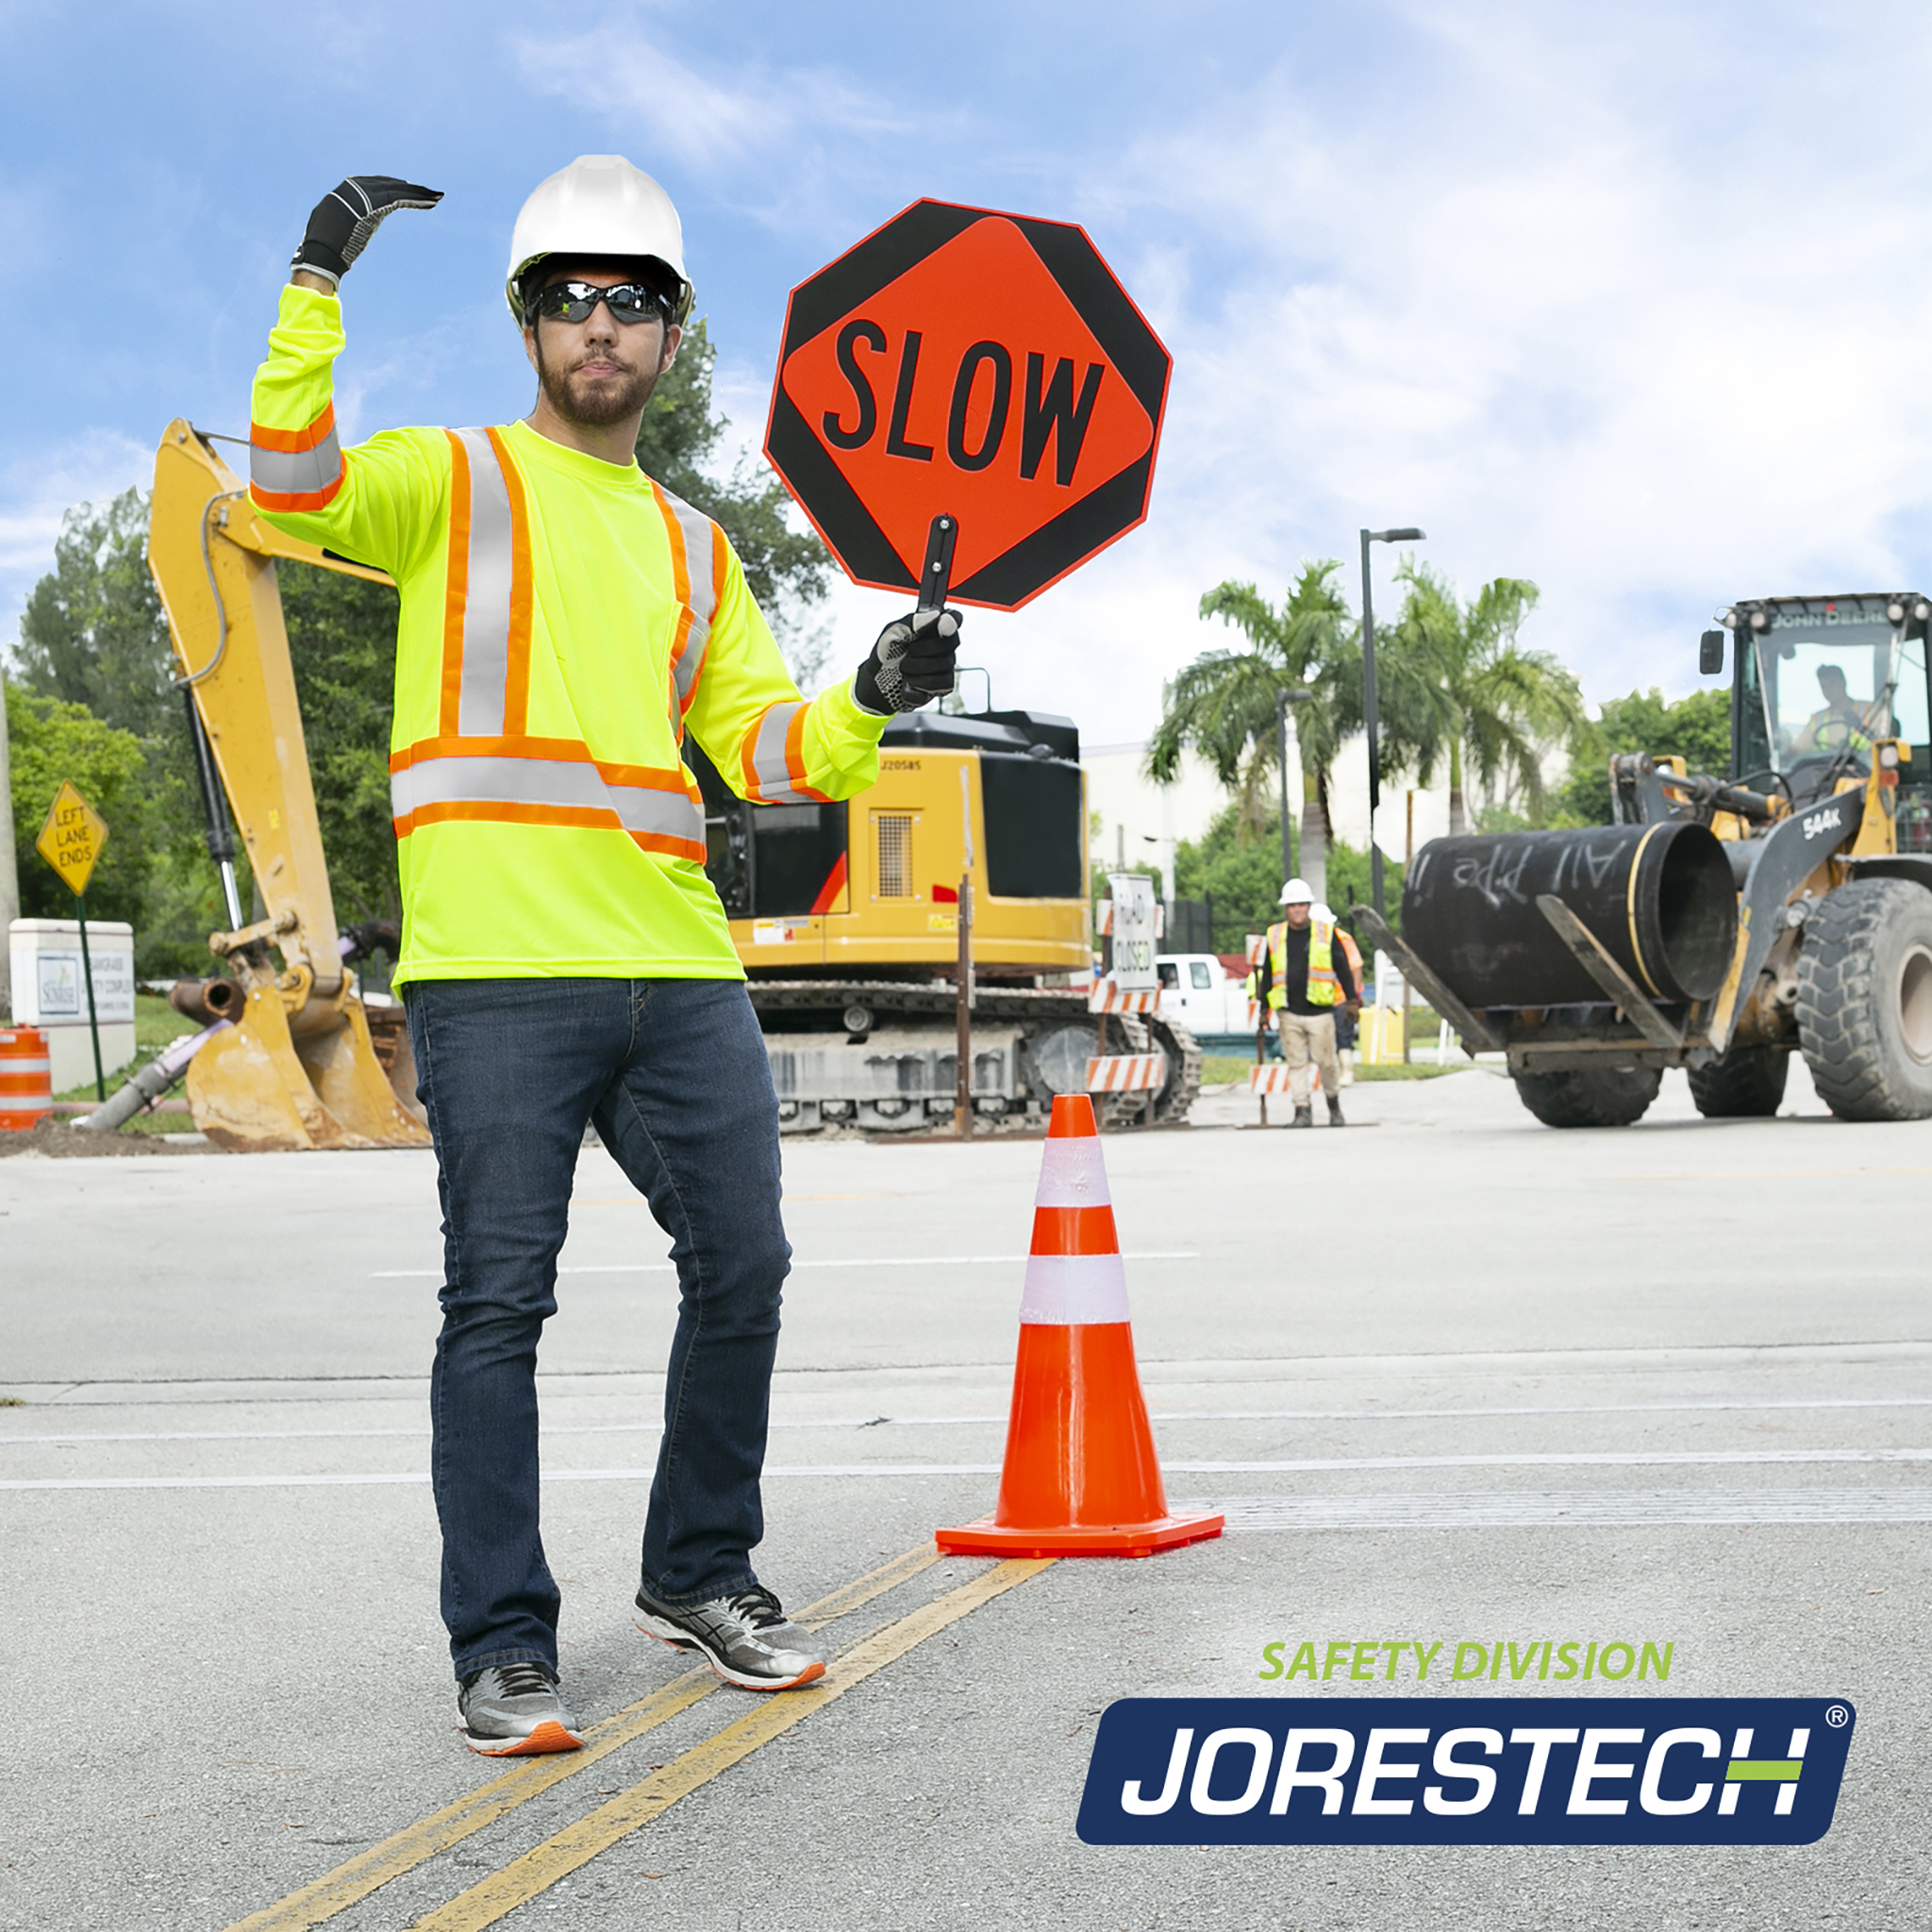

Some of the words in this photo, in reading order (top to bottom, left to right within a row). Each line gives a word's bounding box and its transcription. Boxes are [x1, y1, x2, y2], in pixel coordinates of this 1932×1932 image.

[824, 319, 1106, 488] SLOW
[1772, 612, 1822, 628] JOHN
[55, 807, 85, 826] LEFT
[1803, 808, 1841, 840] 544K
[56, 825, 91, 847] LANE
[58, 845, 92, 868] ENDS
